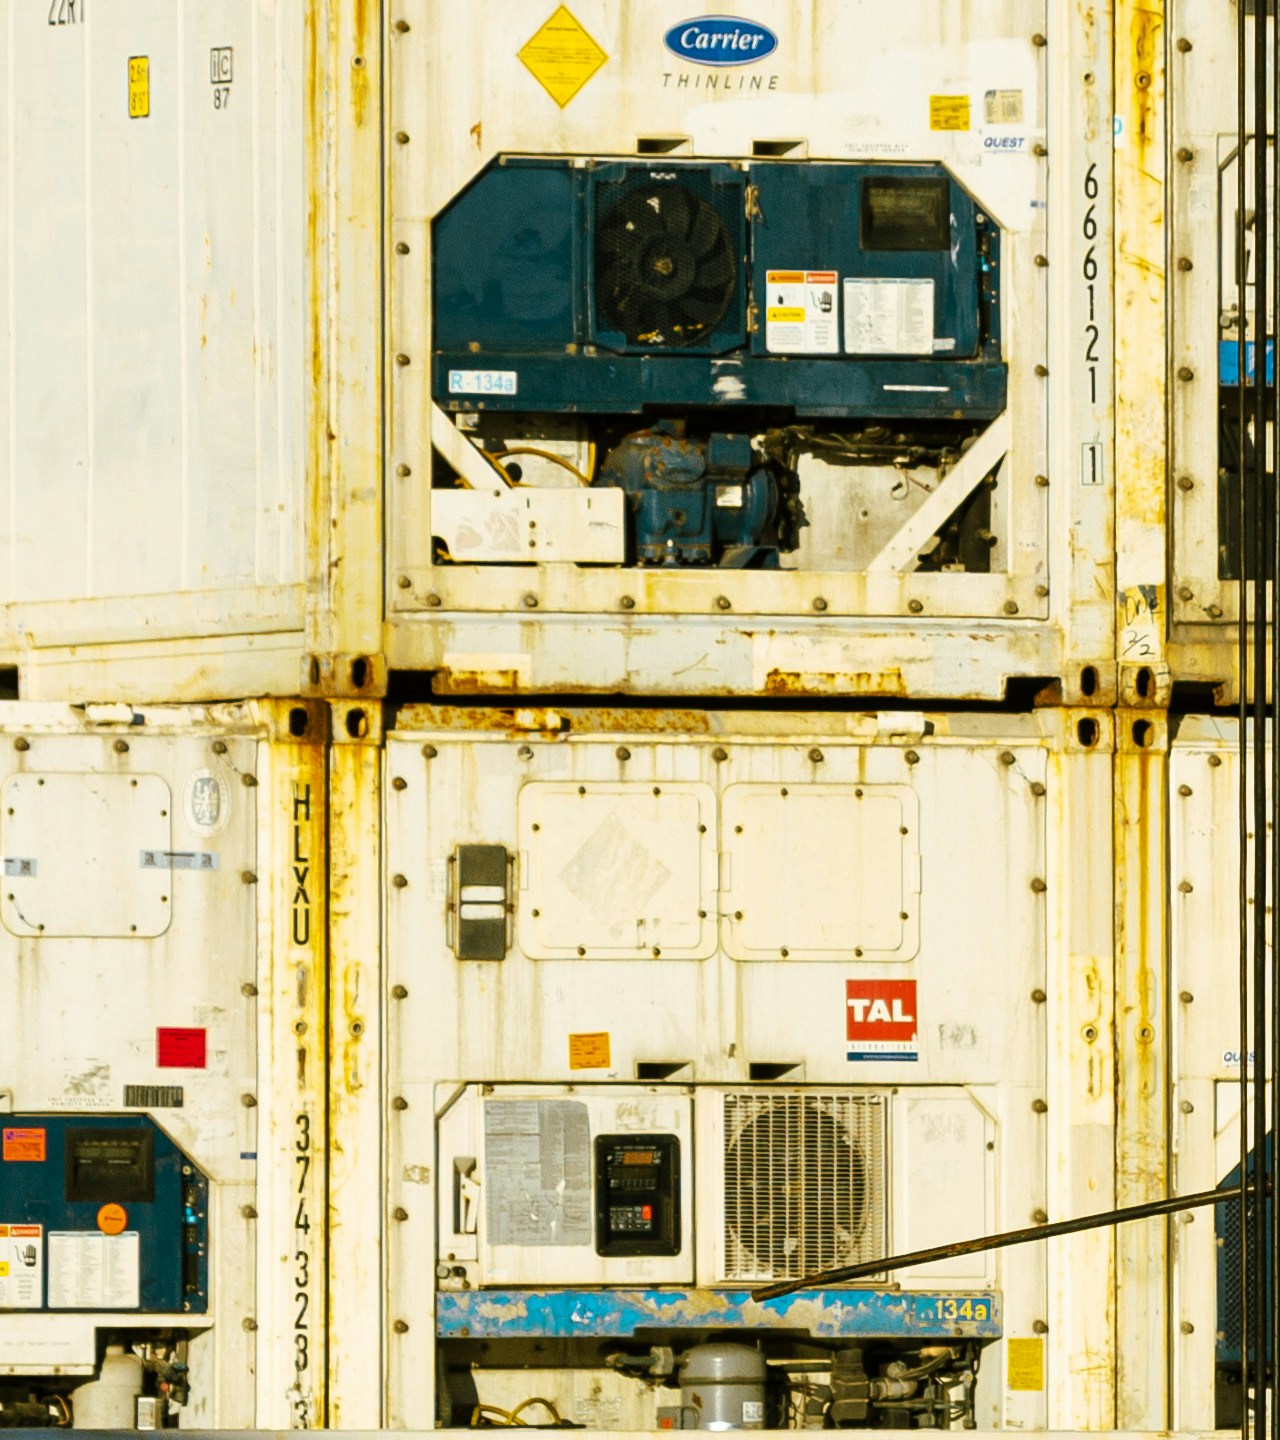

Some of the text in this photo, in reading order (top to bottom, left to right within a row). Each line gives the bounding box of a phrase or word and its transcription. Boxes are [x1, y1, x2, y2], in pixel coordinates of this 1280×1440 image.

[679, 26, 765, 51] Carrier
[662, 72, 779, 91] THINLINE
[213, 87, 230, 110] 87
[984, 136, 1026, 149] QUEST
[1083, 162, 1099, 404] 666121
[449, 371, 517, 394] R-134a
[1088, 445, 1097, 483] 1
[293, 783, 311, 946] HLXU
[847, 998, 913, 1023] TAL
